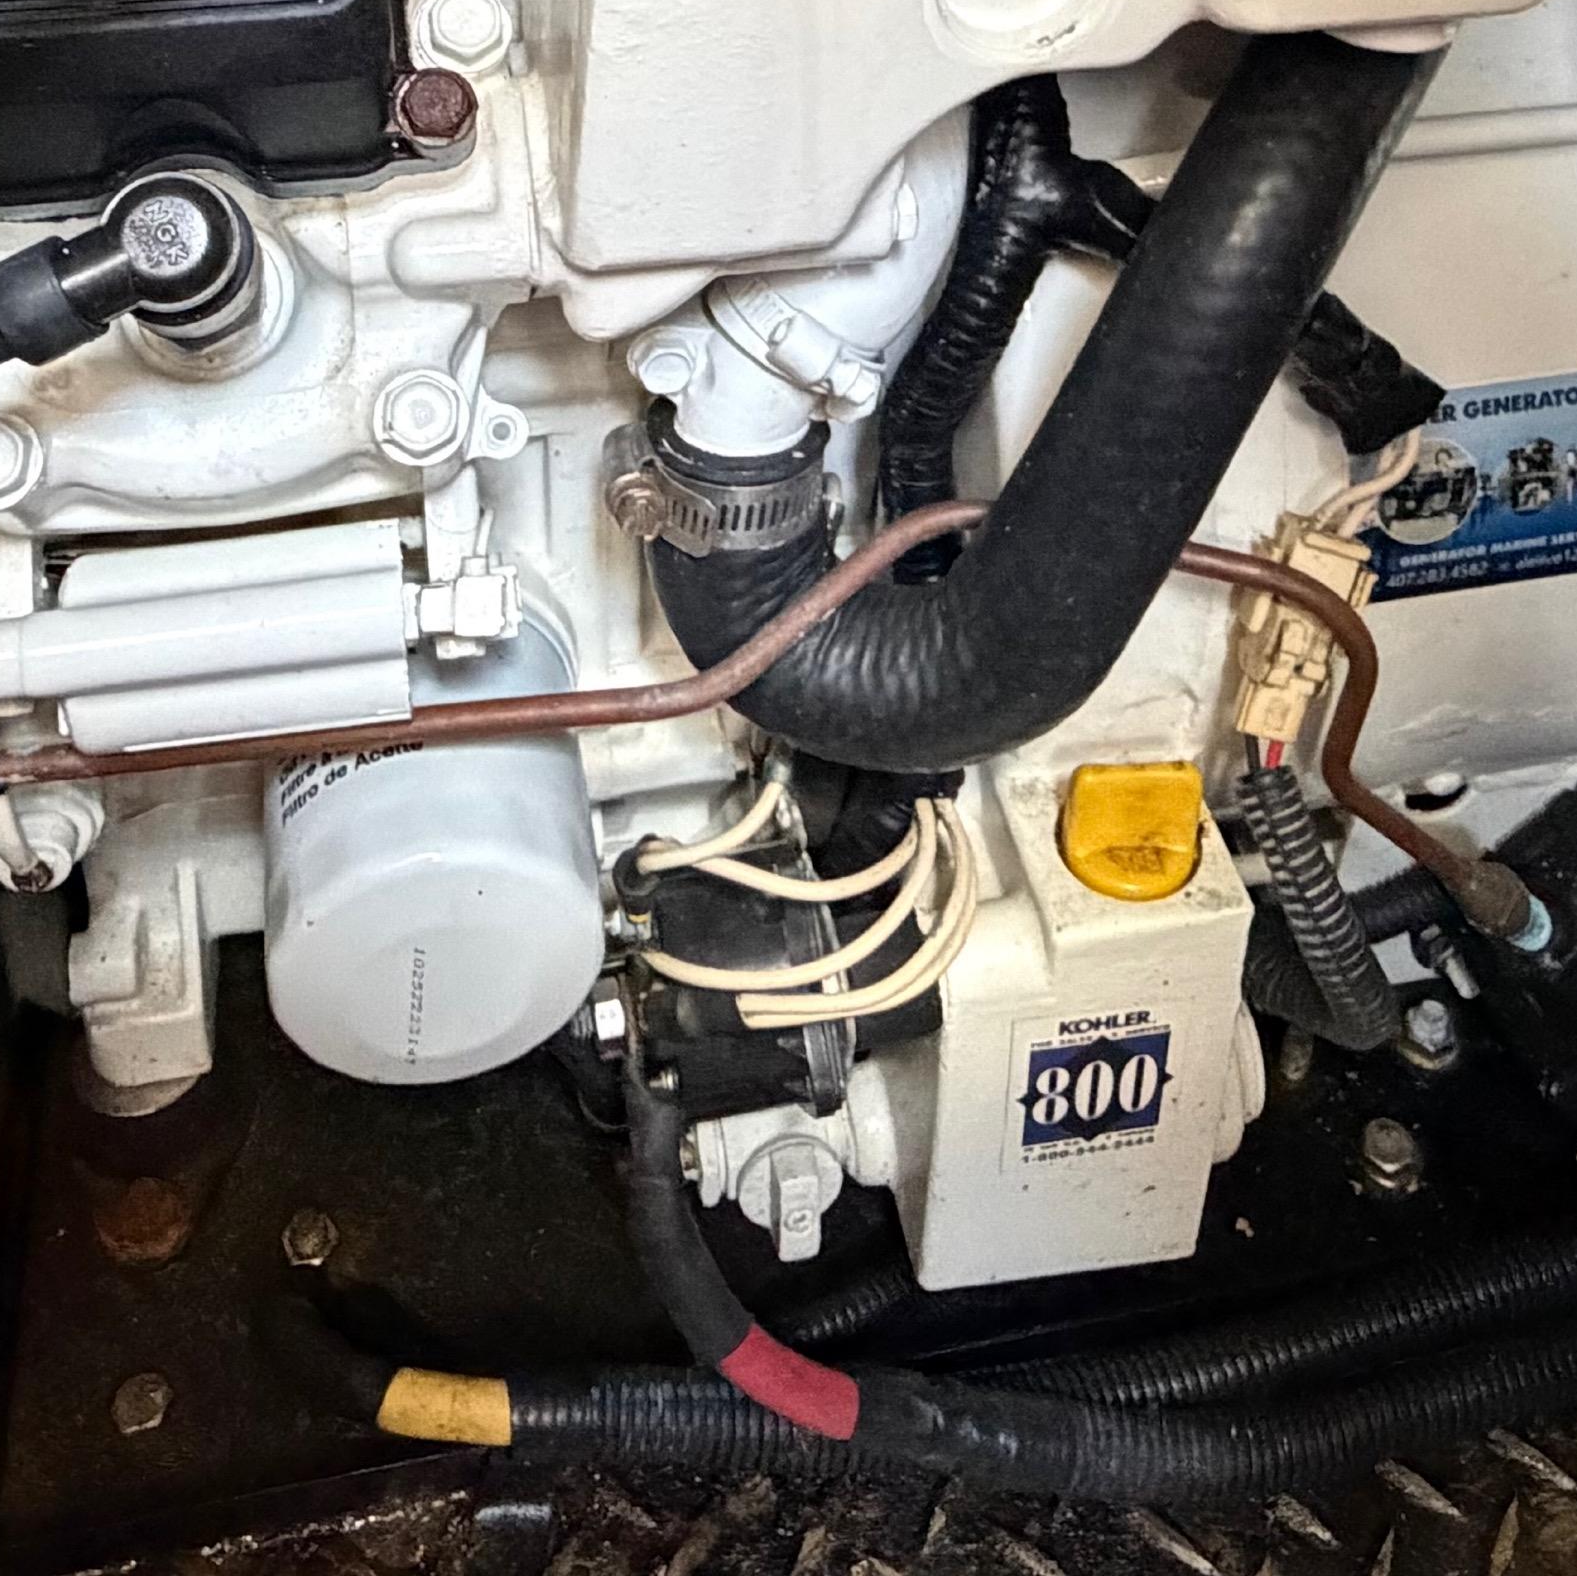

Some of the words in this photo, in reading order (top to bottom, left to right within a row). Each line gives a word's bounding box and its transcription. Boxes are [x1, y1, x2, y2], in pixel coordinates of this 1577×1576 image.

[281, 784, 319, 829] Filtro
[324, 765, 348, 786] de
[1059, 1010, 1152, 1036] KOHLER
[1032, 1054, 1159, 1126] 800
